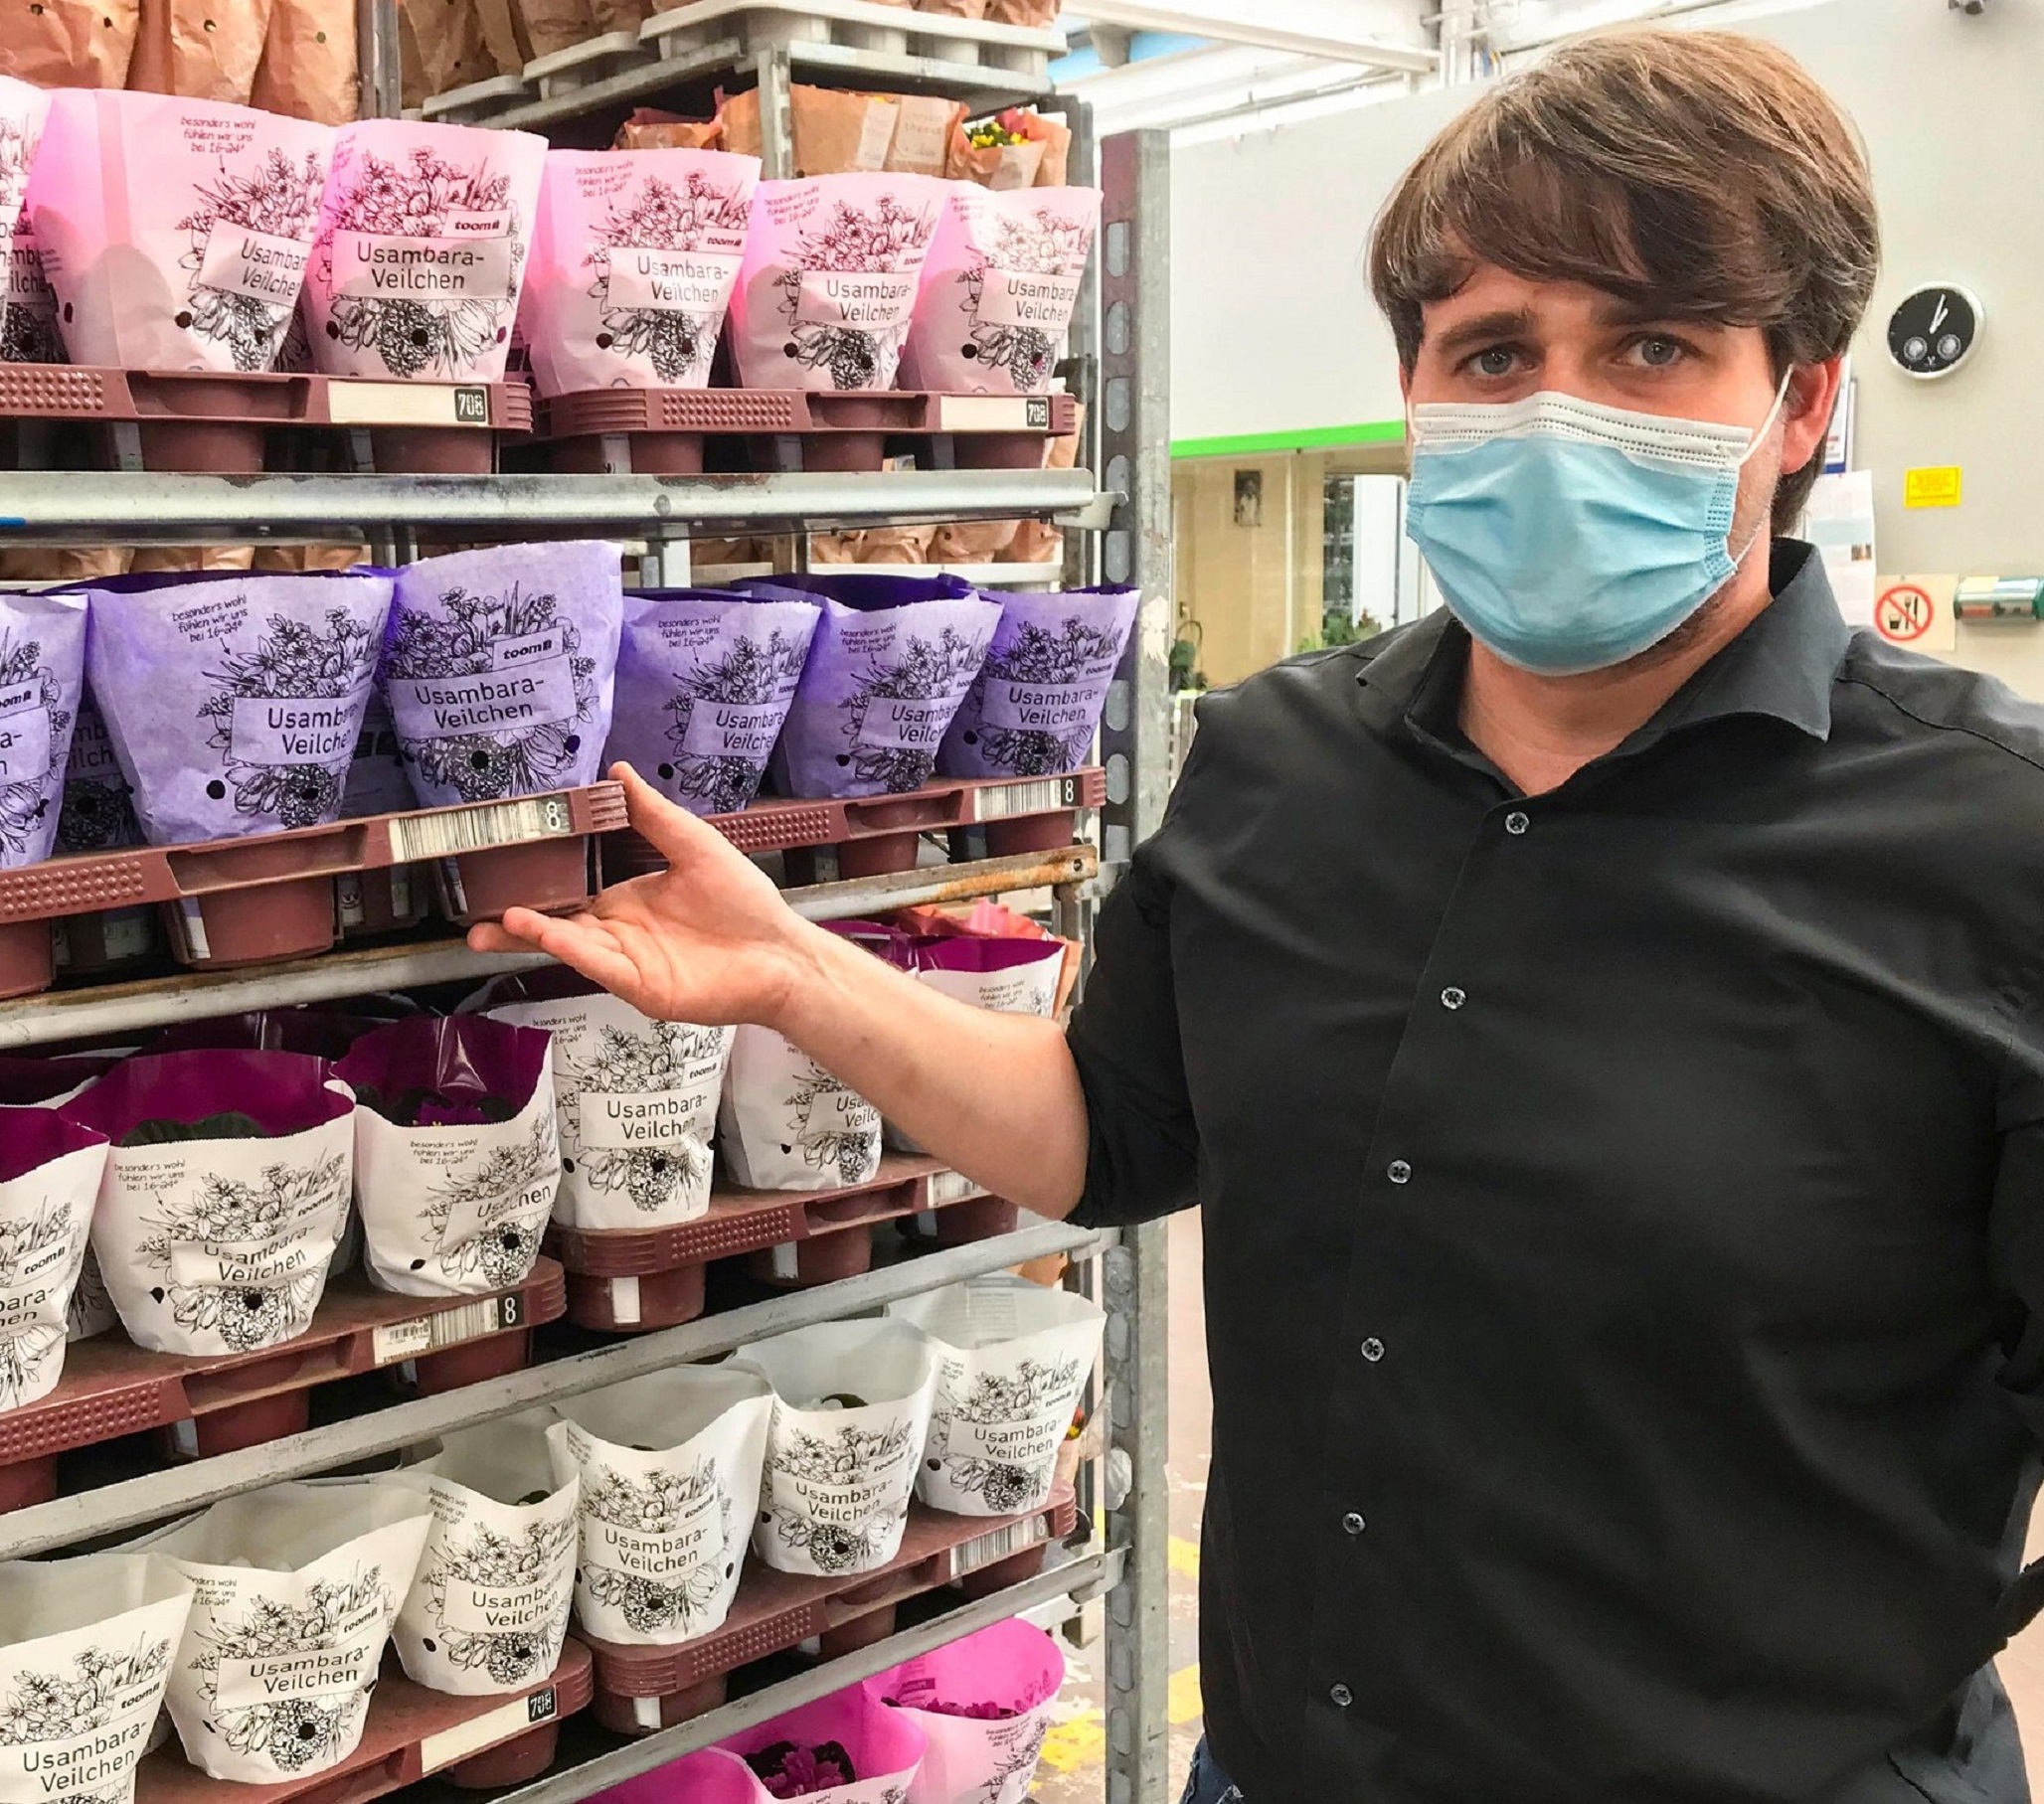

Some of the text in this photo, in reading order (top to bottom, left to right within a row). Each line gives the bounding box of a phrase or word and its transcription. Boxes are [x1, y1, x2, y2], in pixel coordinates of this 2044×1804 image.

[357, 241, 485, 266] Usambara-
[372, 267, 465, 290] Veilchen
[637, 254, 729, 280] Usambara-
[242, 265, 298, 297] Veilche
[651, 280, 719, 303] Veilchen
[826, 278, 911, 299] Usambara-
[839, 302, 900, 321] Veilchen
[1016, 300, 1068, 322] Veilchen
[457, 393, 484, 416] 708
[1027, 404, 1047, 423] 708
[171, 593, 248, 622] besonders wohl
[178, 608, 248, 633] fühlen wir uns
[189, 631, 205, 643] bei
[503, 643, 542, 660] toom
[414, 677, 545, 706] Usambara-
[1008, 686, 1099, 706] Usambara-
[434, 701, 533, 731] Veilchen
[1019, 708, 1087, 725] Veilchen
[1064, 778, 1075, 803] 8
[546, 800, 562, 831] 8
[606, 1093, 708, 1119] Usambara-
[114, 1159, 186, 1172] besonders wohl
[149, 1172, 165, 1181] wir
[126, 1182, 141, 1191] bei
[204, 1226, 316, 1266] Usambara-
[24, 1251, 58, 1275] toom
[218, 1248, 307, 1282] Veilchen
[504, 1296, 517, 1324] 8
[974, 1418, 1062, 1442] Usambara-
[985, 1438, 1053, 1459] Veilchen
[795, 1479, 893, 1505] Usambara-
[807, 1498, 881, 1522] Veilchen
[1037, 1514, 1046, 1537] 8
[604, 1528, 708, 1555] Usambara-
[618, 1549, 697, 1573] Veilchen
[485, 1590, 559, 1627] Veilchen
[250, 1644, 371, 1678] Usambara-
[263, 1668, 359, 1695] Veilchen
[120, 1690, 153, 1710] toom
[23, 1720, 147, 1772] Usambara-
[40, 1749, 135, 1793] Veilchen
